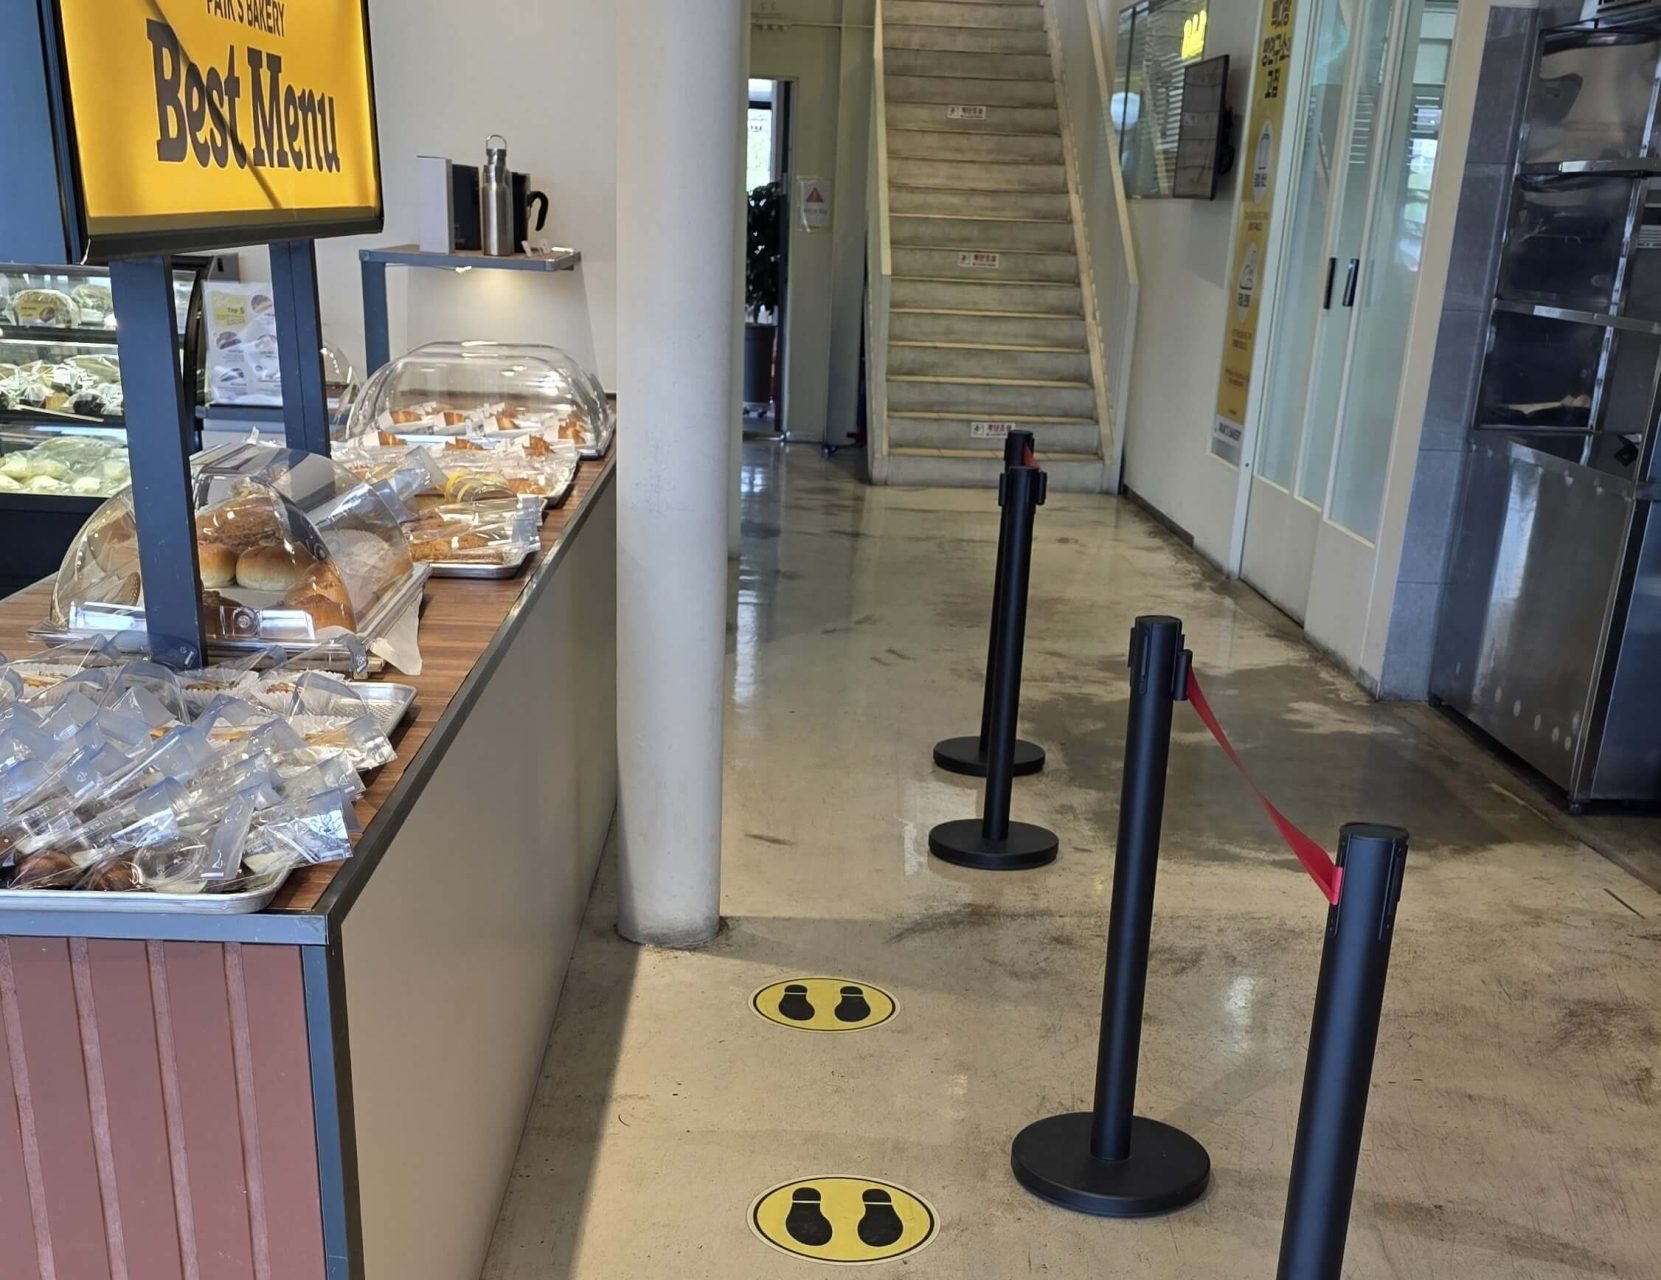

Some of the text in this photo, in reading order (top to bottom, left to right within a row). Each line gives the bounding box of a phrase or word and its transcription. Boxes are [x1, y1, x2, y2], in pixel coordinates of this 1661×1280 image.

[246, 0, 285, 38] BAKERY
[146, 18, 341, 173] Best Menu
